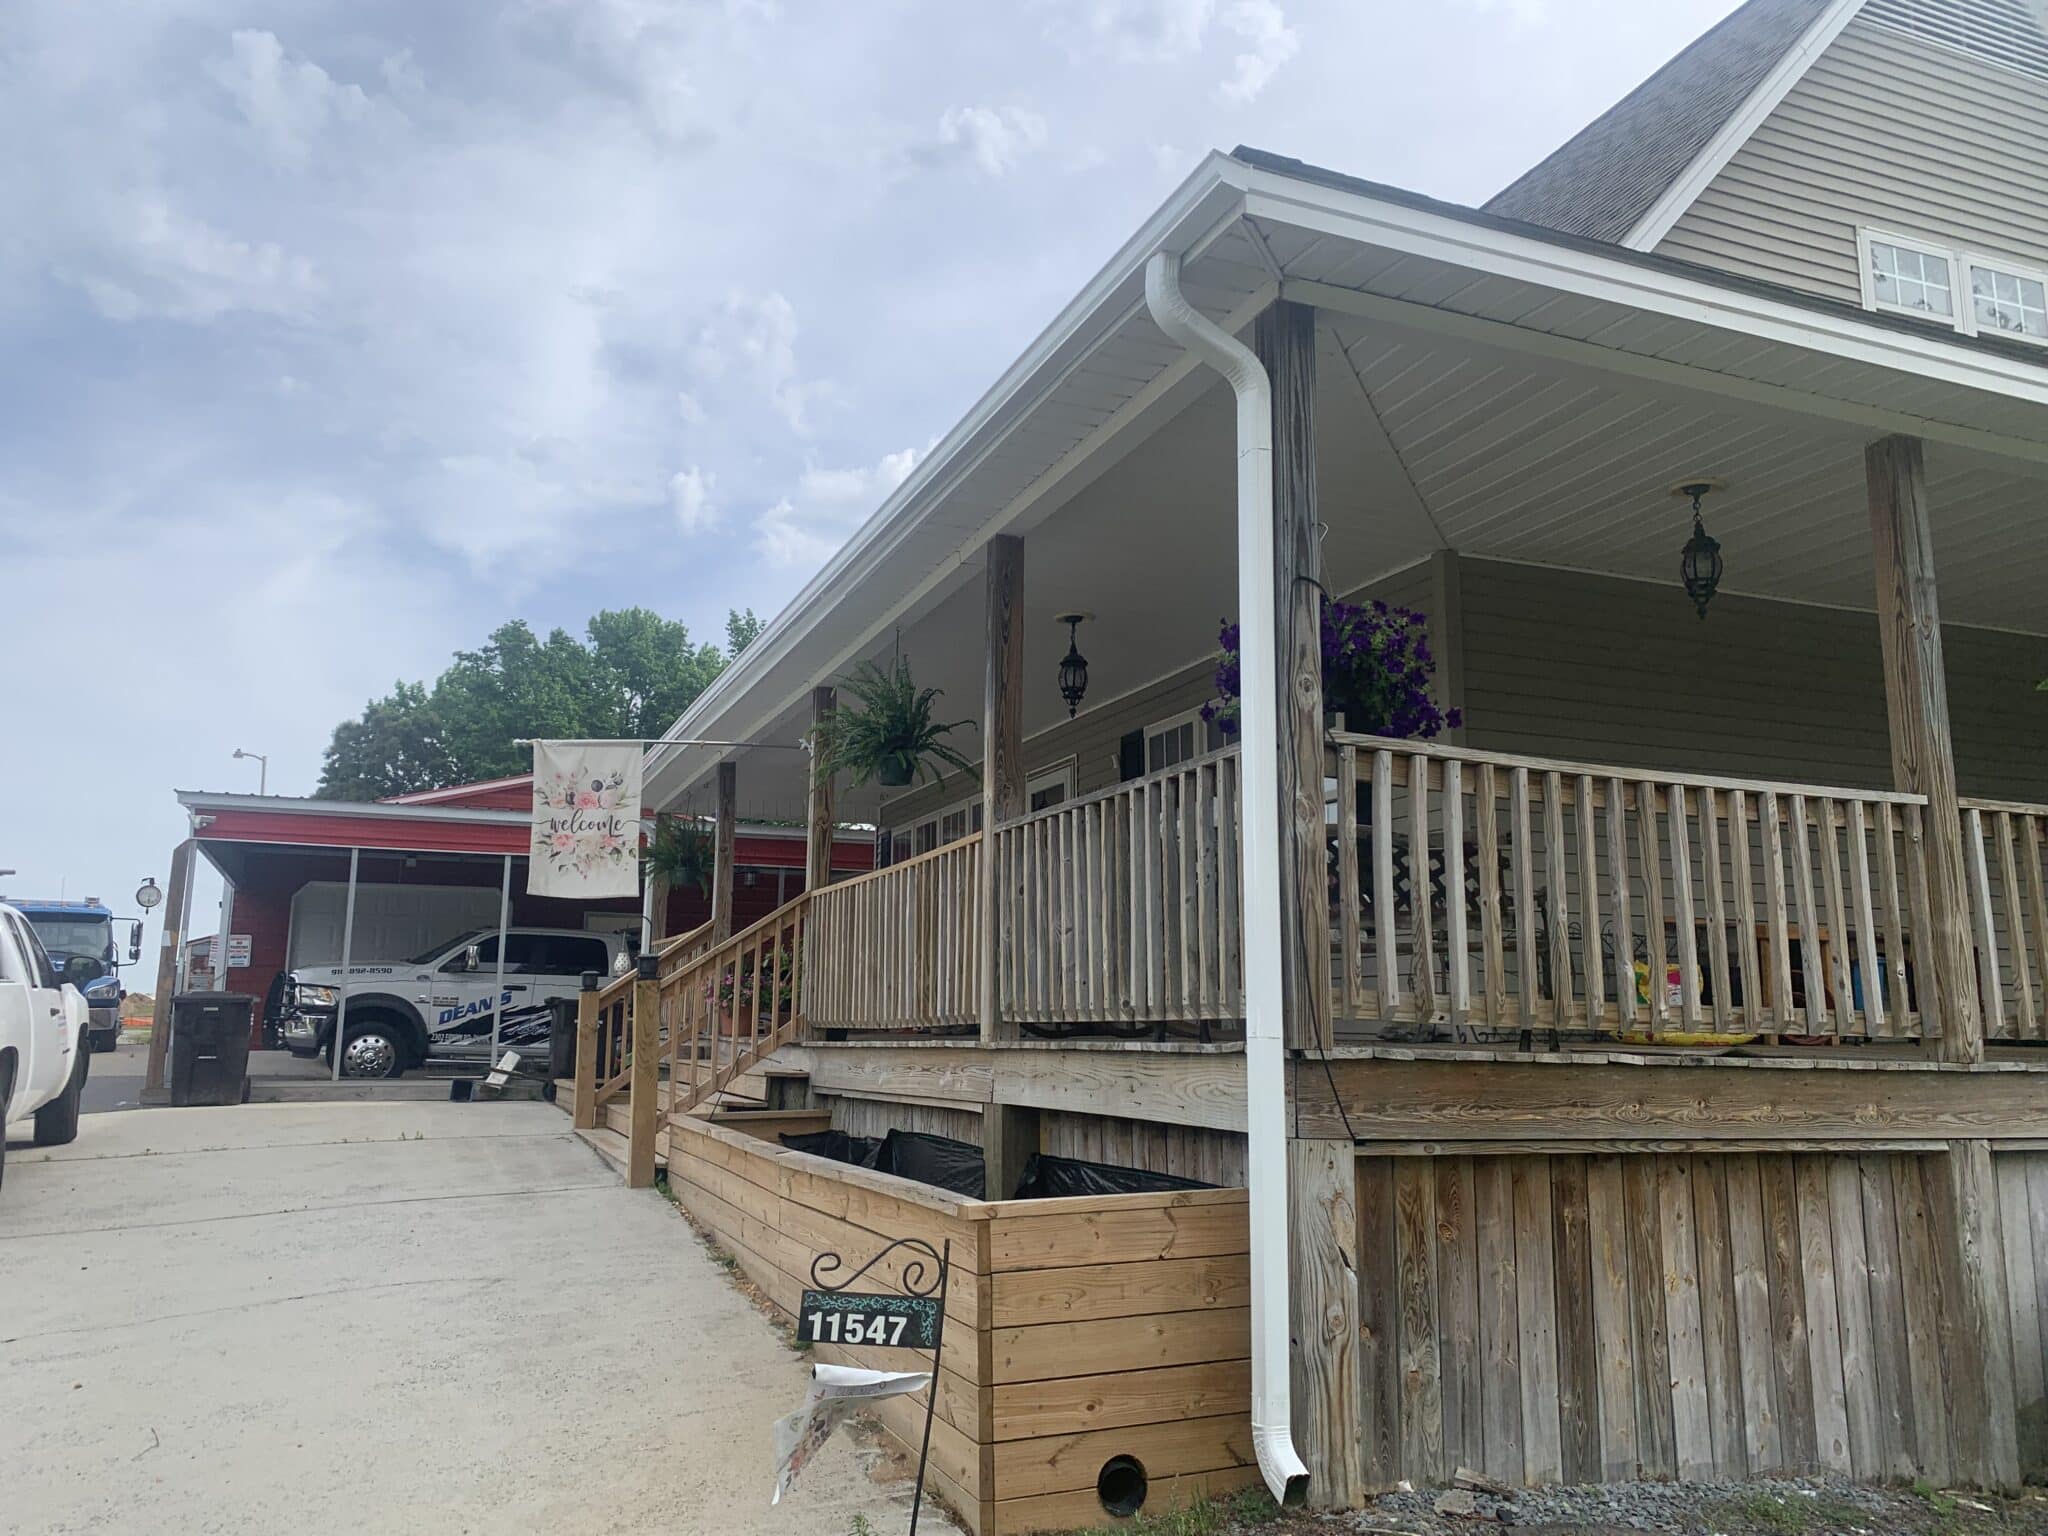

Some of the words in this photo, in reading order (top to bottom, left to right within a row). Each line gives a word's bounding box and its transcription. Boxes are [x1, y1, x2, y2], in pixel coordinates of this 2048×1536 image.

[550, 808, 625, 838] welcome
[439, 991, 512, 1025] DEANS
[808, 1311, 907, 1346] 11547
